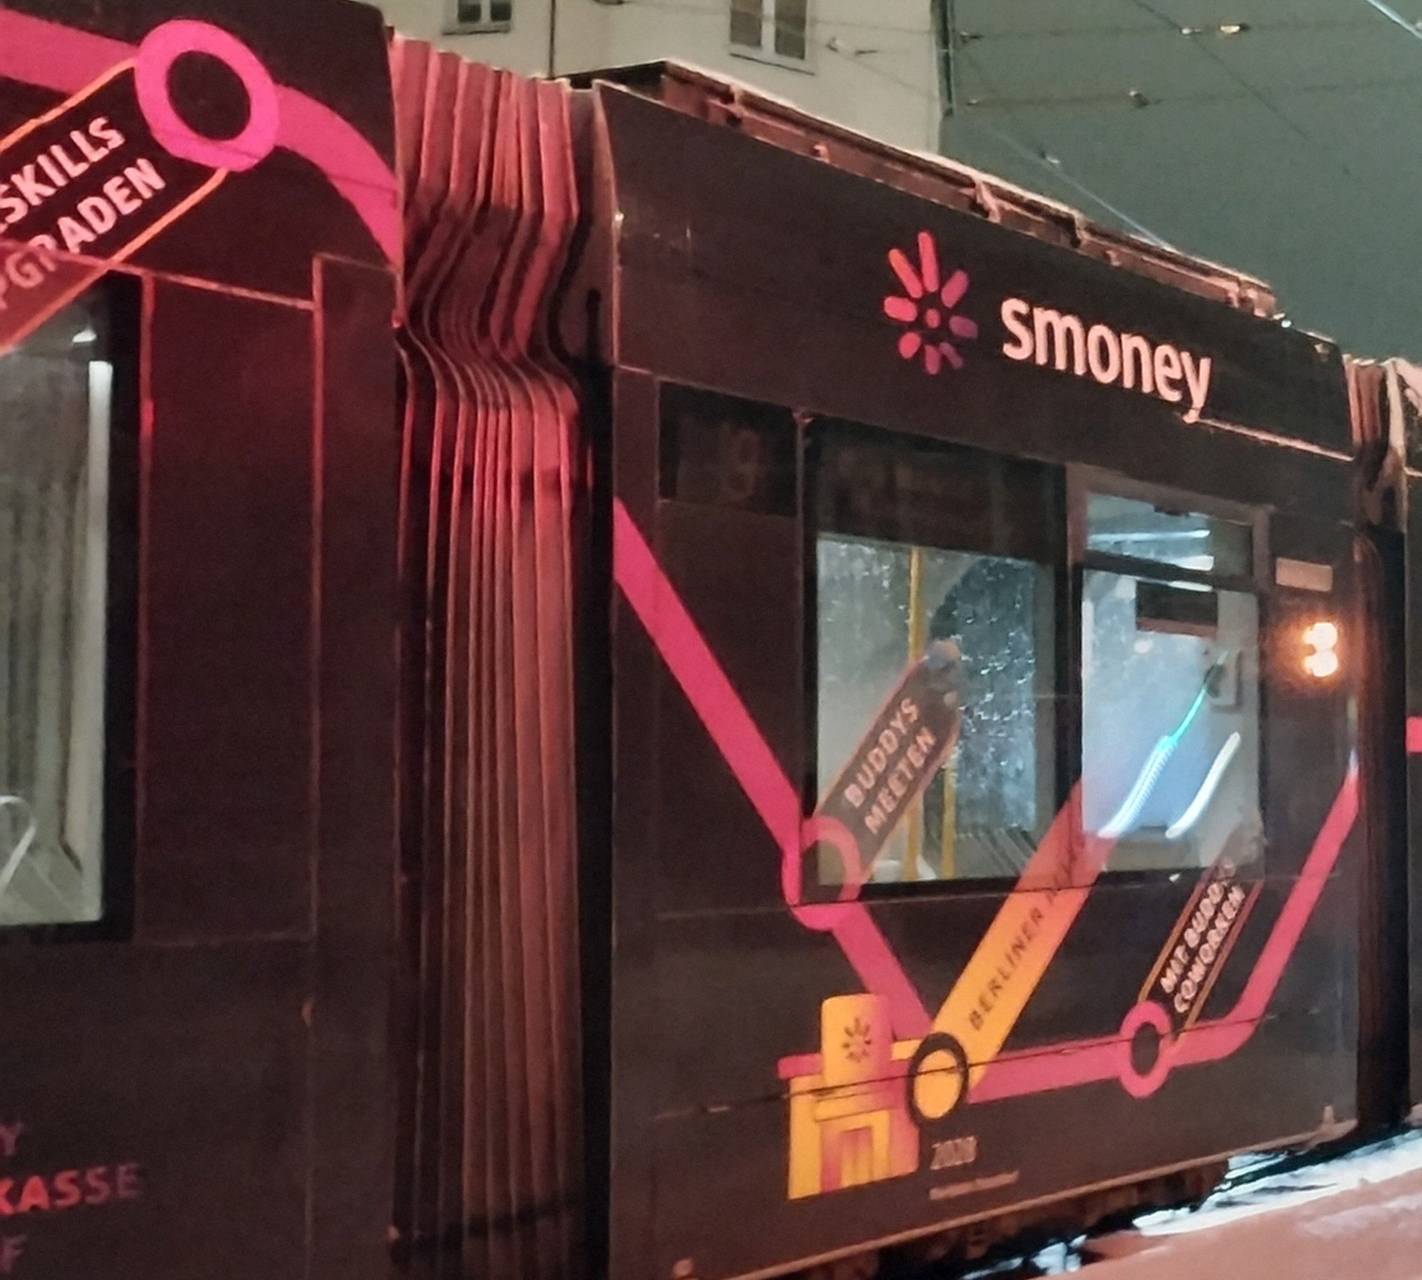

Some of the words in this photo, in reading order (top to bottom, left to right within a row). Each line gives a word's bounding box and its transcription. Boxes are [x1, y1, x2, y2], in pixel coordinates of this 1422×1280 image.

[0, 117, 126, 233] SKILLS
[1000, 297, 1212, 424] smoney
[844, 698, 918, 808] BUDDYS
[864, 727, 936, 835] MEETEN
[968, 906, 1044, 1031] BERLINER
